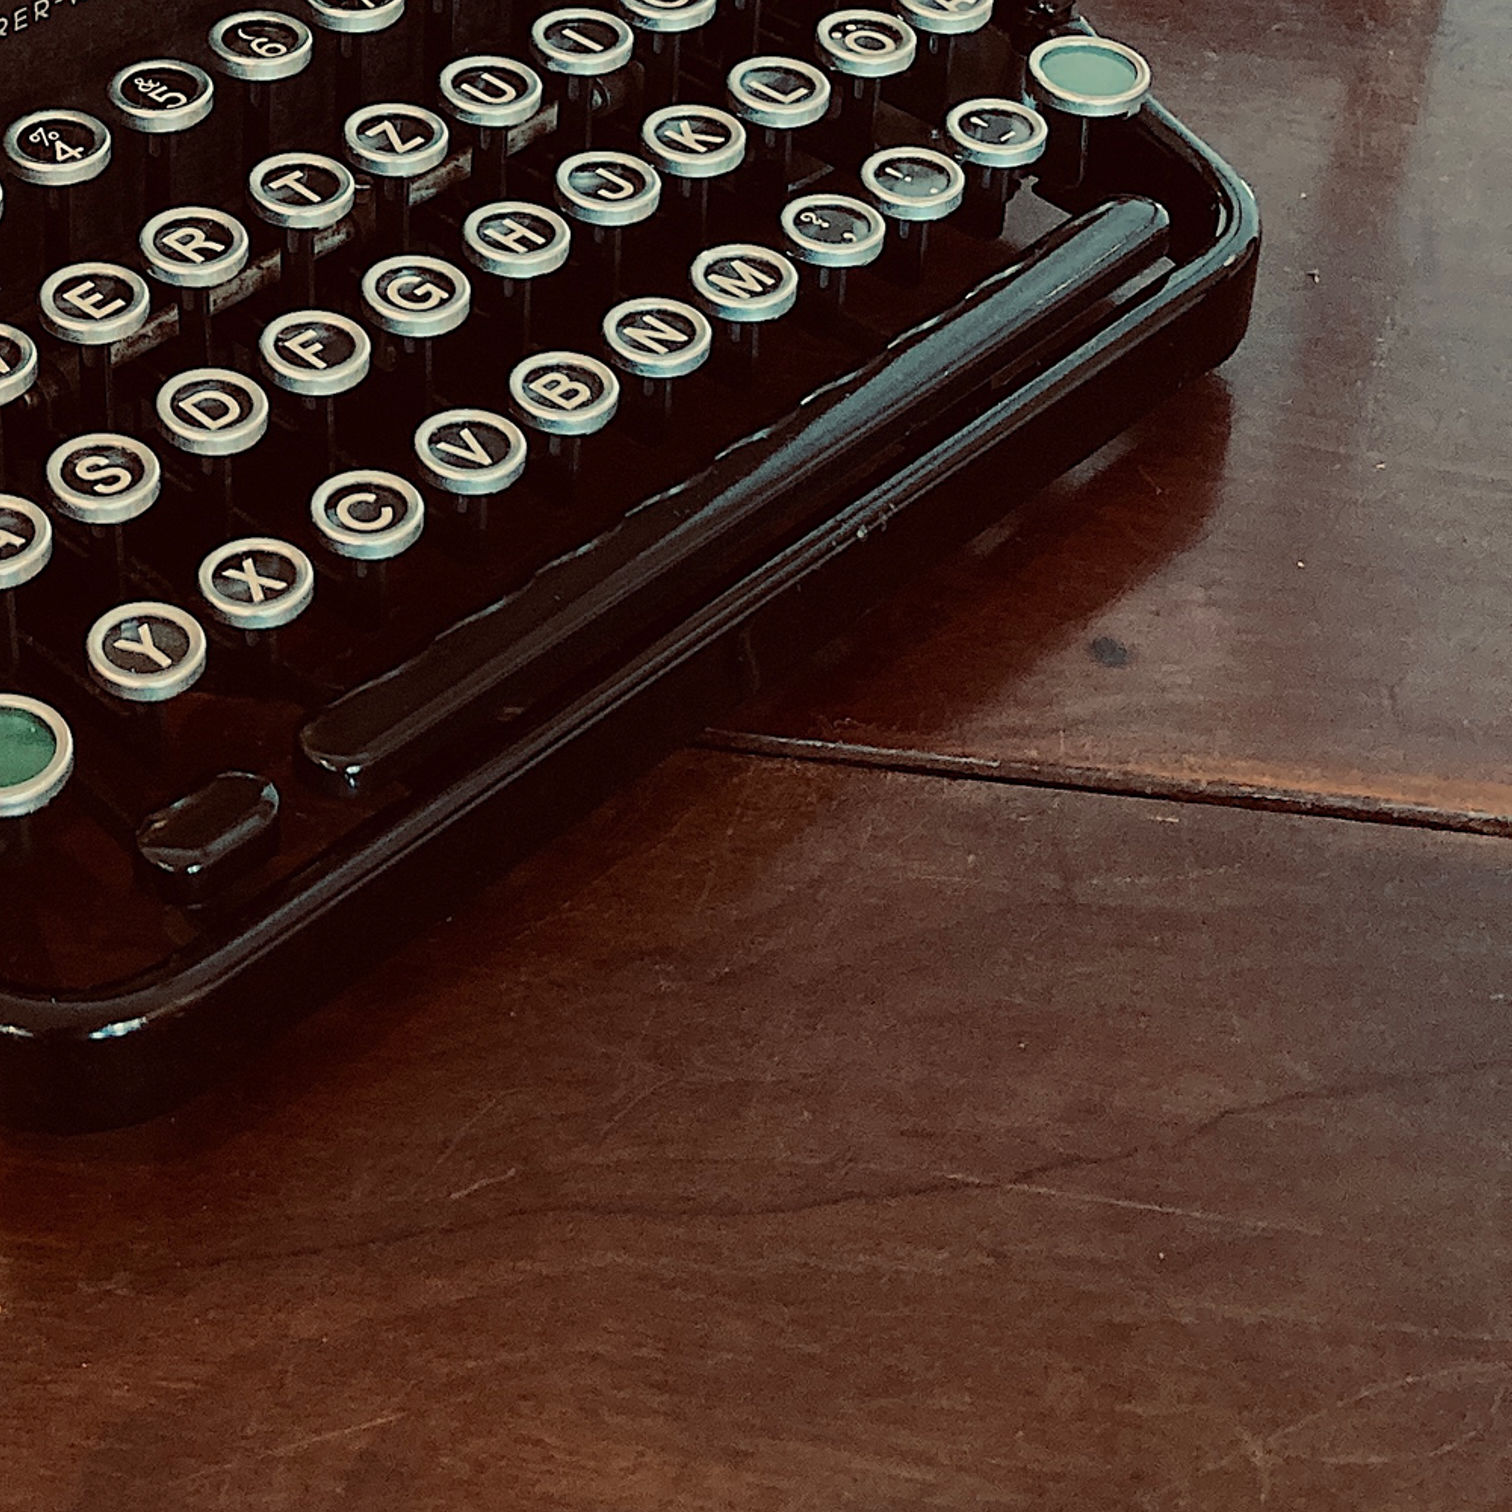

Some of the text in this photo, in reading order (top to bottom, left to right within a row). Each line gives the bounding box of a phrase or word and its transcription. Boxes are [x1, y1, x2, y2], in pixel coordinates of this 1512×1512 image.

[250, 36, 287, 58] 6
[561, 28, 605, 53] I
[148, 85, 187, 109] 5
[460, 72, 517, 106] U
[748, 79, 809, 105] L
[55, 140, 85, 163] 4
[365, 120, 426, 154] Z
[663, 120, 726, 152] K
[268, 170, 322, 204] T
[593, 167, 634, 201] J
[161, 226, 226, 264] R
[484, 218, 547, 254] H
[387, 275, 450, 310] G
[706, 259, 777, 299] M
[62, 280, 126, 320] E
[284, 329, 329, 369] F
[622, 314, 690, 355] N
[528, 370, 591, 411] B
[177, 389, 241, 430] D
[435, 427, 493, 467] V
[74, 454, 133, 495] S
[334, 491, 395, 532] C
[220, 556, 288, 603] X
[113, 622, 173, 669] Y
